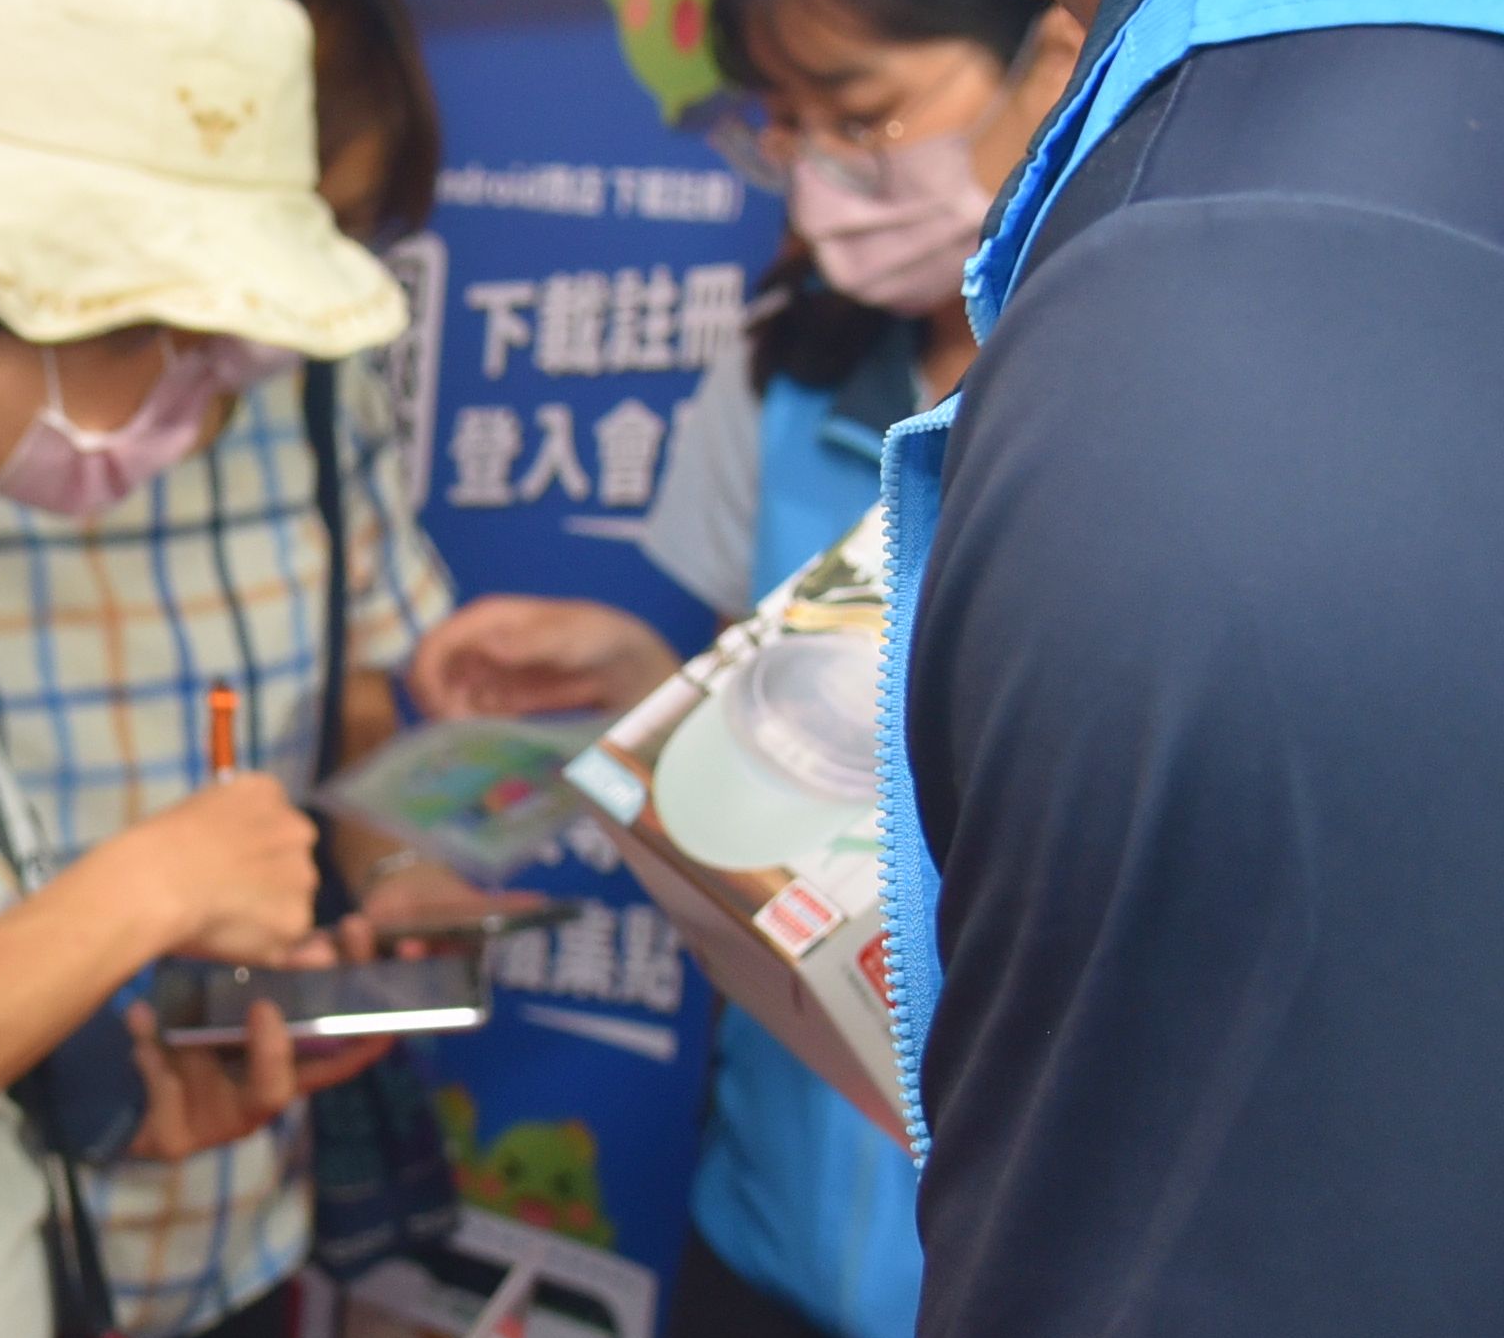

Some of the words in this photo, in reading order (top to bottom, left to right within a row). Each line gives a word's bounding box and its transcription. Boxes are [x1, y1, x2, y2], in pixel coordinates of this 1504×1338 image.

[464, 263, 746, 379] 下載註冊
[447, 397, 694, 508] 登入會
